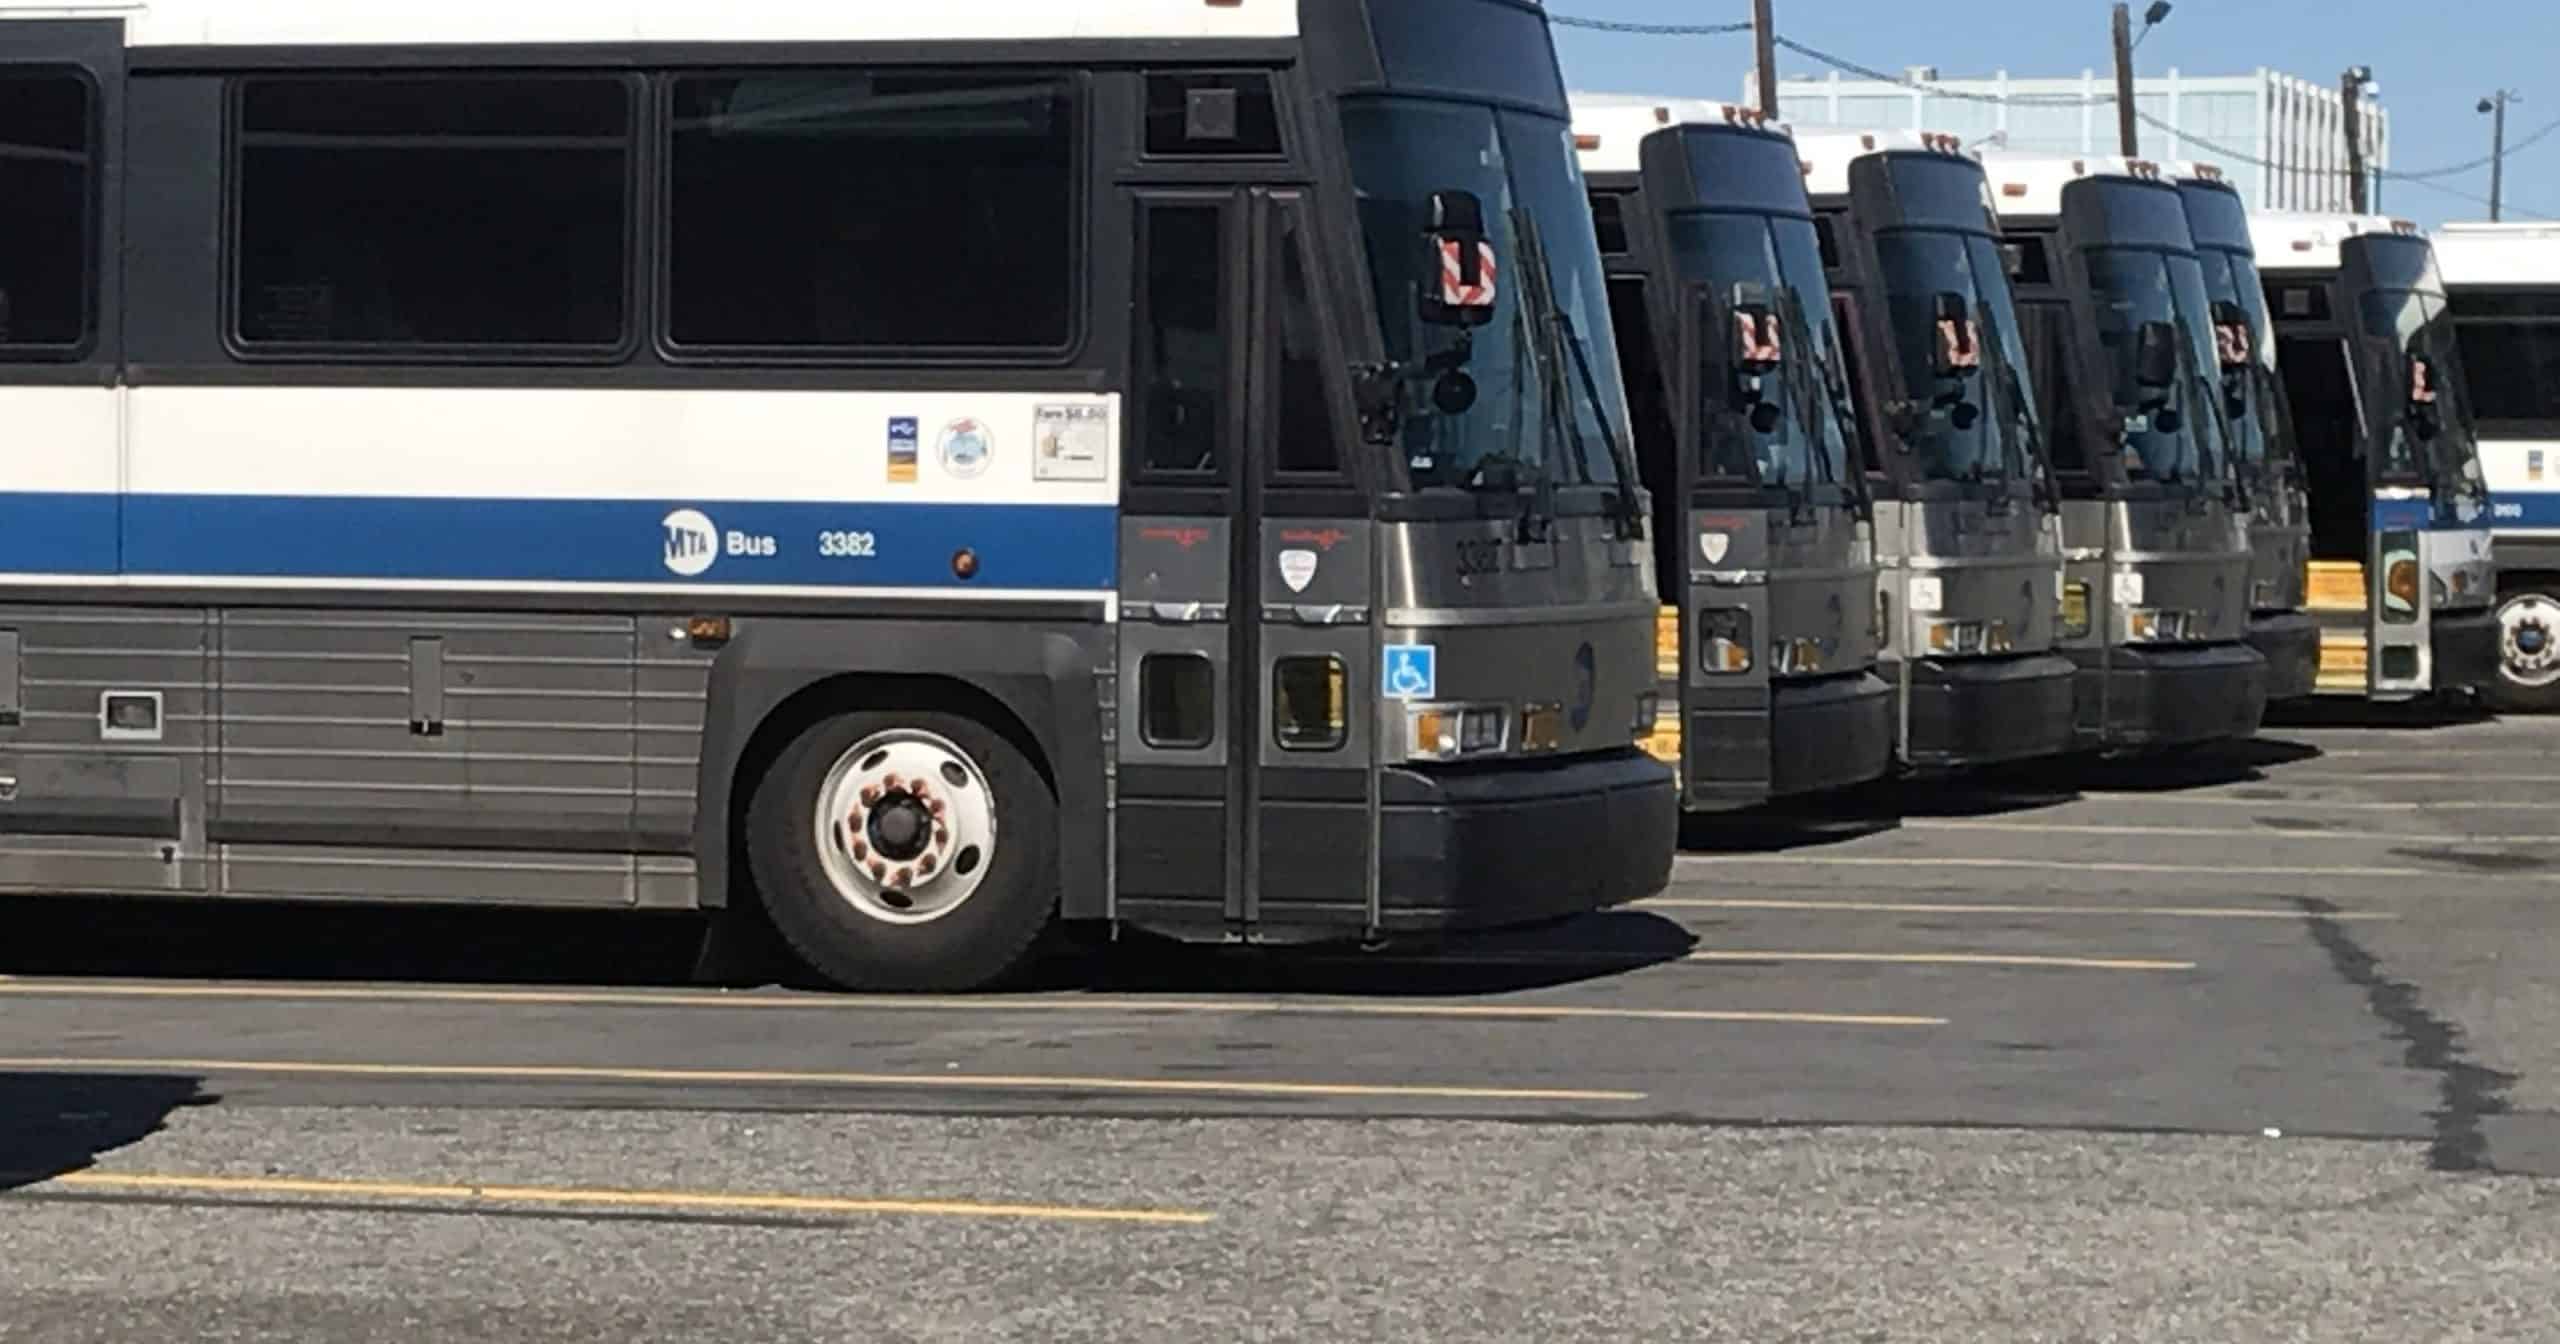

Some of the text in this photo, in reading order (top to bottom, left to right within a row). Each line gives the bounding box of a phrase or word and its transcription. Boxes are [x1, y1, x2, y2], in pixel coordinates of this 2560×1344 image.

[663, 526, 777, 560] MTA Bus
[819, 530, 876, 557] 3382
